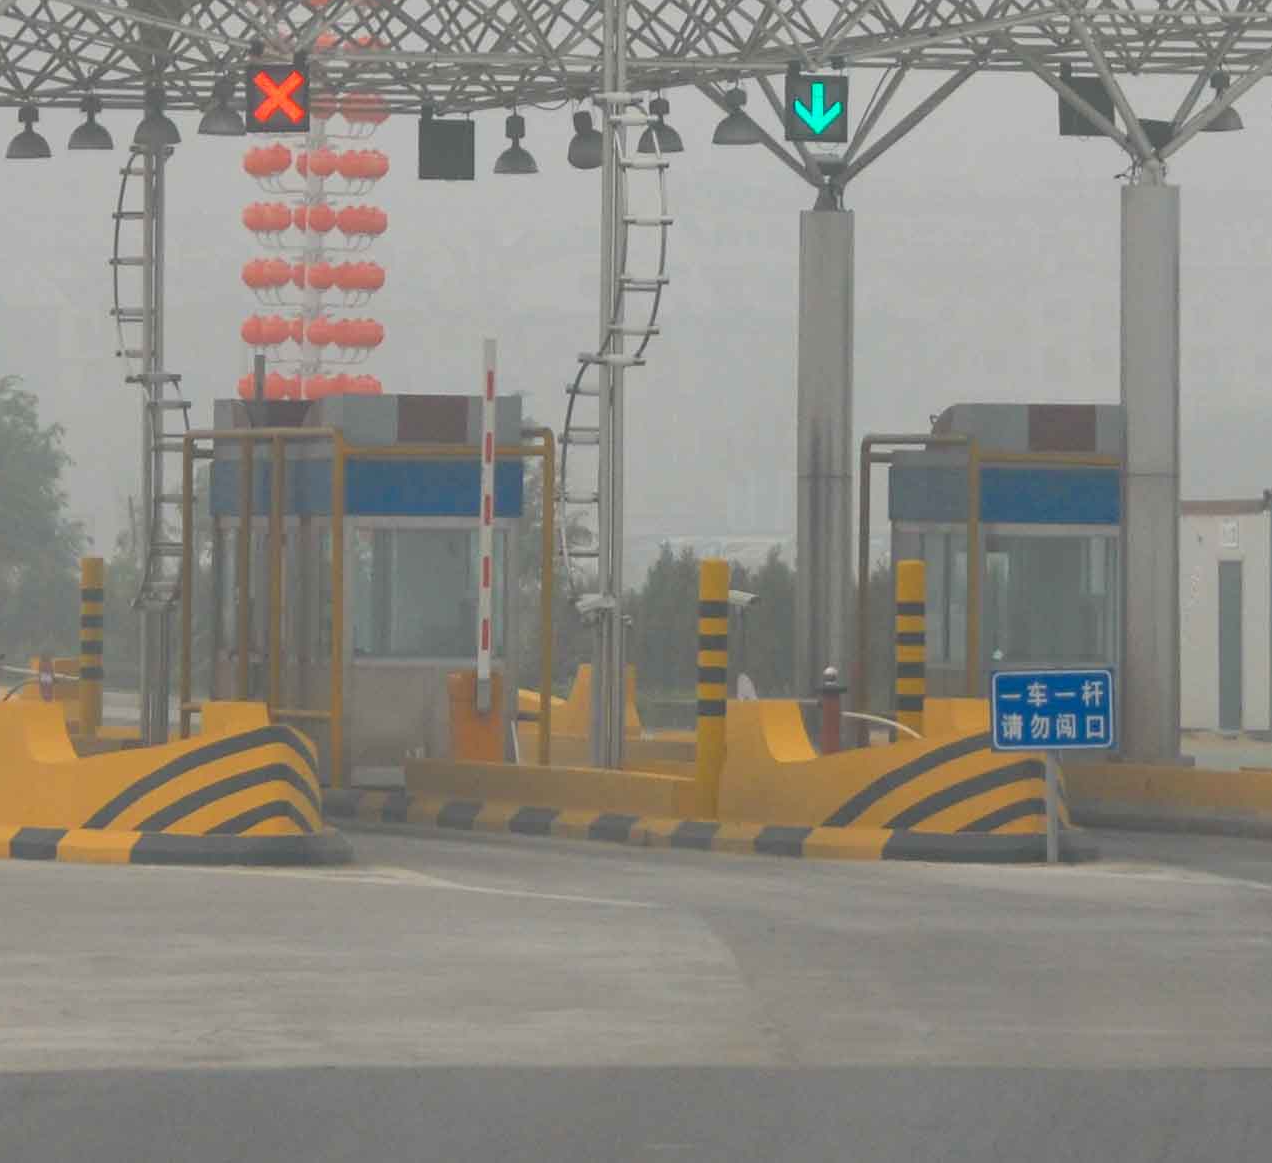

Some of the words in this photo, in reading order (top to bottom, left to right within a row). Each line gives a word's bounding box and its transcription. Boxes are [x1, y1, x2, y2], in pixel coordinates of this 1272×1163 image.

[1000, 680, 1104, 708] 一车一杆
[1001, 712, 1105, 740] 请勿闯口
